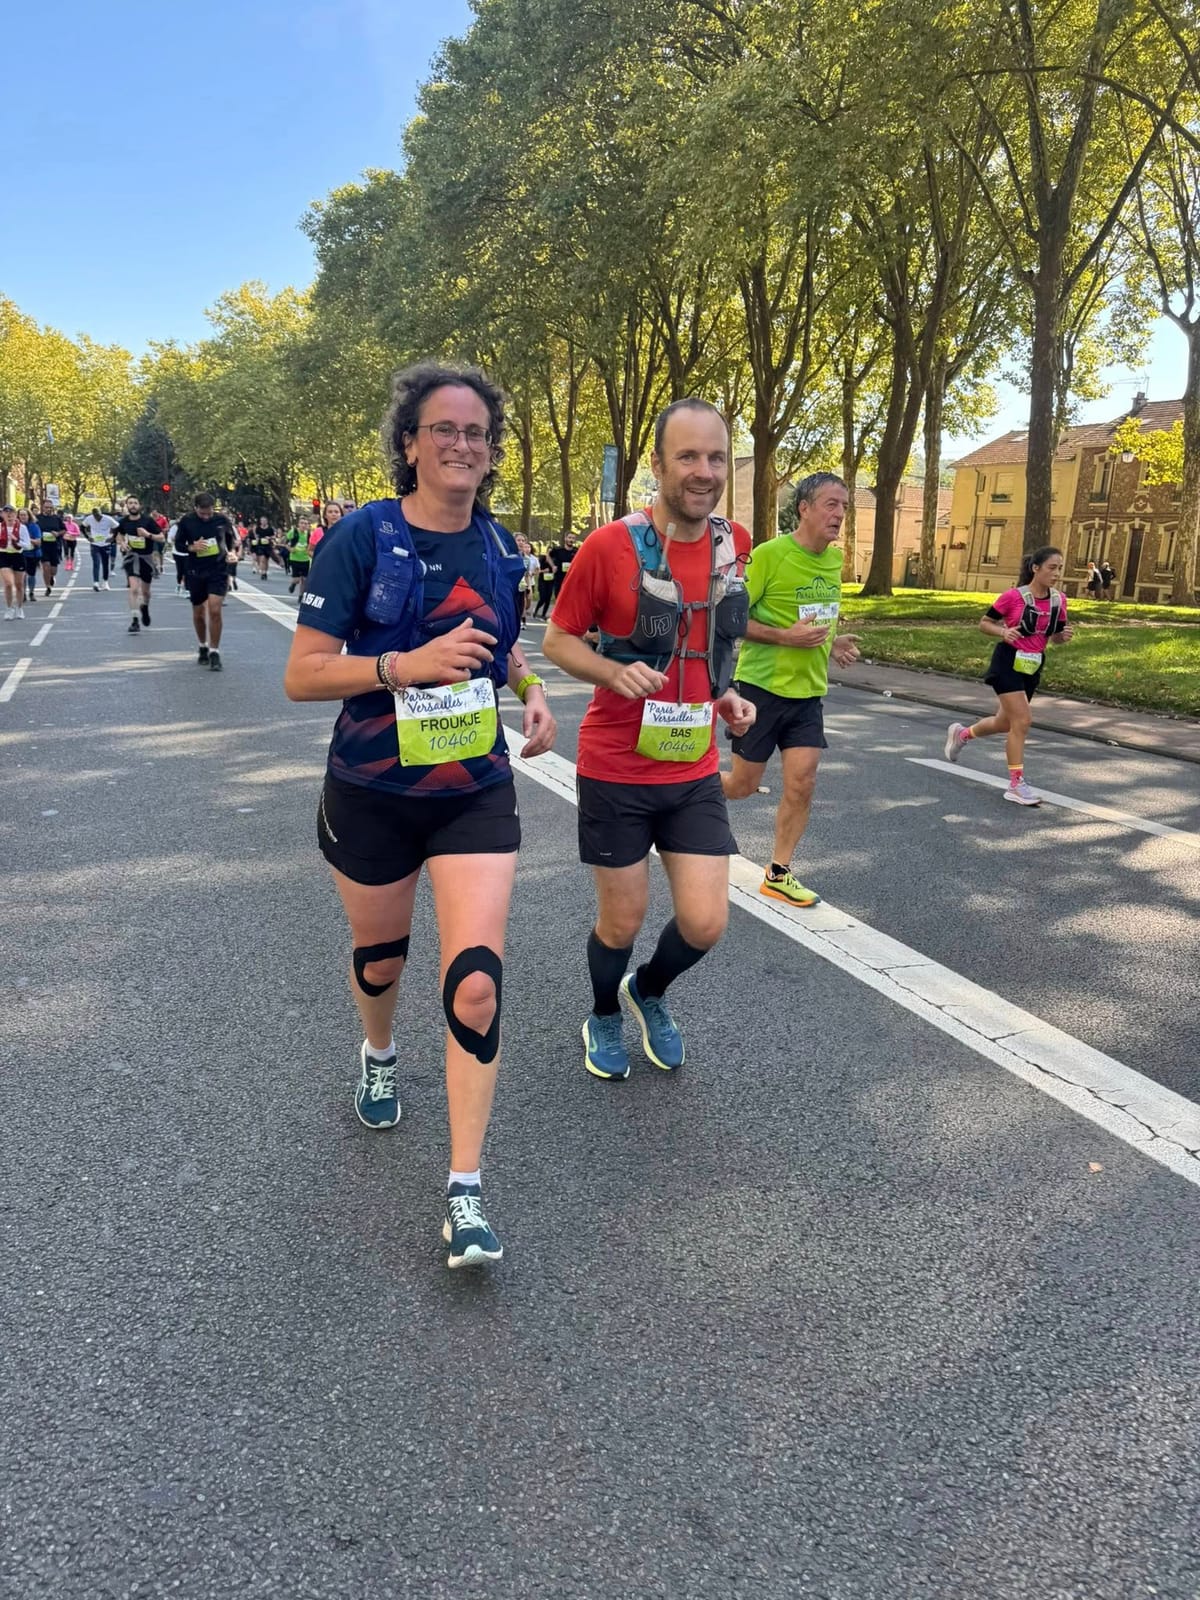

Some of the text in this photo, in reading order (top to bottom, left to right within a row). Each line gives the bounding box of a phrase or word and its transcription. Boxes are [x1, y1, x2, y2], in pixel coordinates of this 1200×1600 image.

[402, 687, 434, 704] Paris
[408, 694, 463, 713] Versailles
[649, 703, 674, 714] Paris
[420, 712, 481, 732] FROUKJE
[653, 711, 694, 722] Versailles
[429, 730, 477, 750] 10460
[670, 728, 692, 738] BAS
[658, 741, 696, 753] 10464
